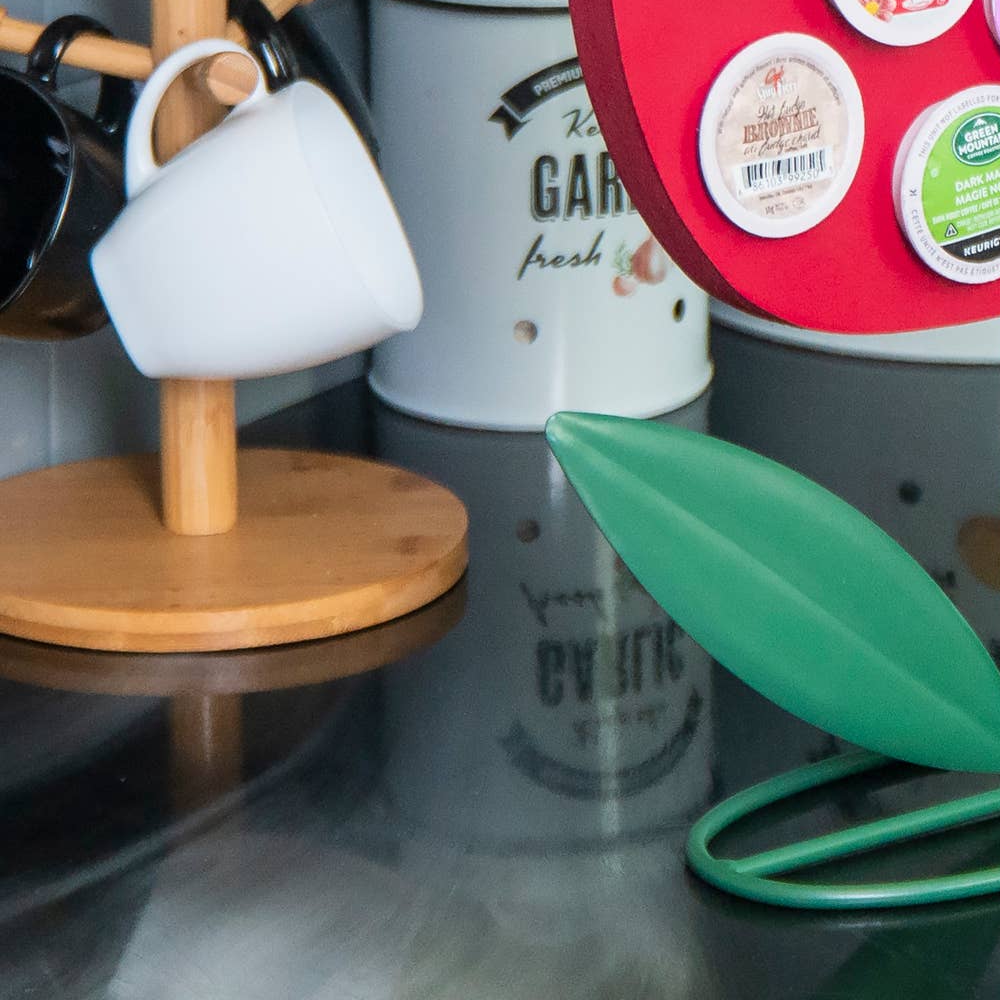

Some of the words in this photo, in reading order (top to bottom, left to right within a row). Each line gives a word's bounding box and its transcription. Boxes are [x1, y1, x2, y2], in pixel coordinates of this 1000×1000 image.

[533, 66, 583, 97] PREMIU
[562, 108, 601, 139] Ke
[742, 108, 819, 144] BROWNIE
[918, 139, 930, 158] THIS
[941, 110, 952, 124] NOT
[986, 95, 999, 103] FOR
[964, 123, 999, 142] GREEN
[955, 174, 984, 193] DARK
[955, 188, 989, 206] MAGIE
[516, 230, 605, 281] fresh
[963, 238, 1000, 257] KEURIG
